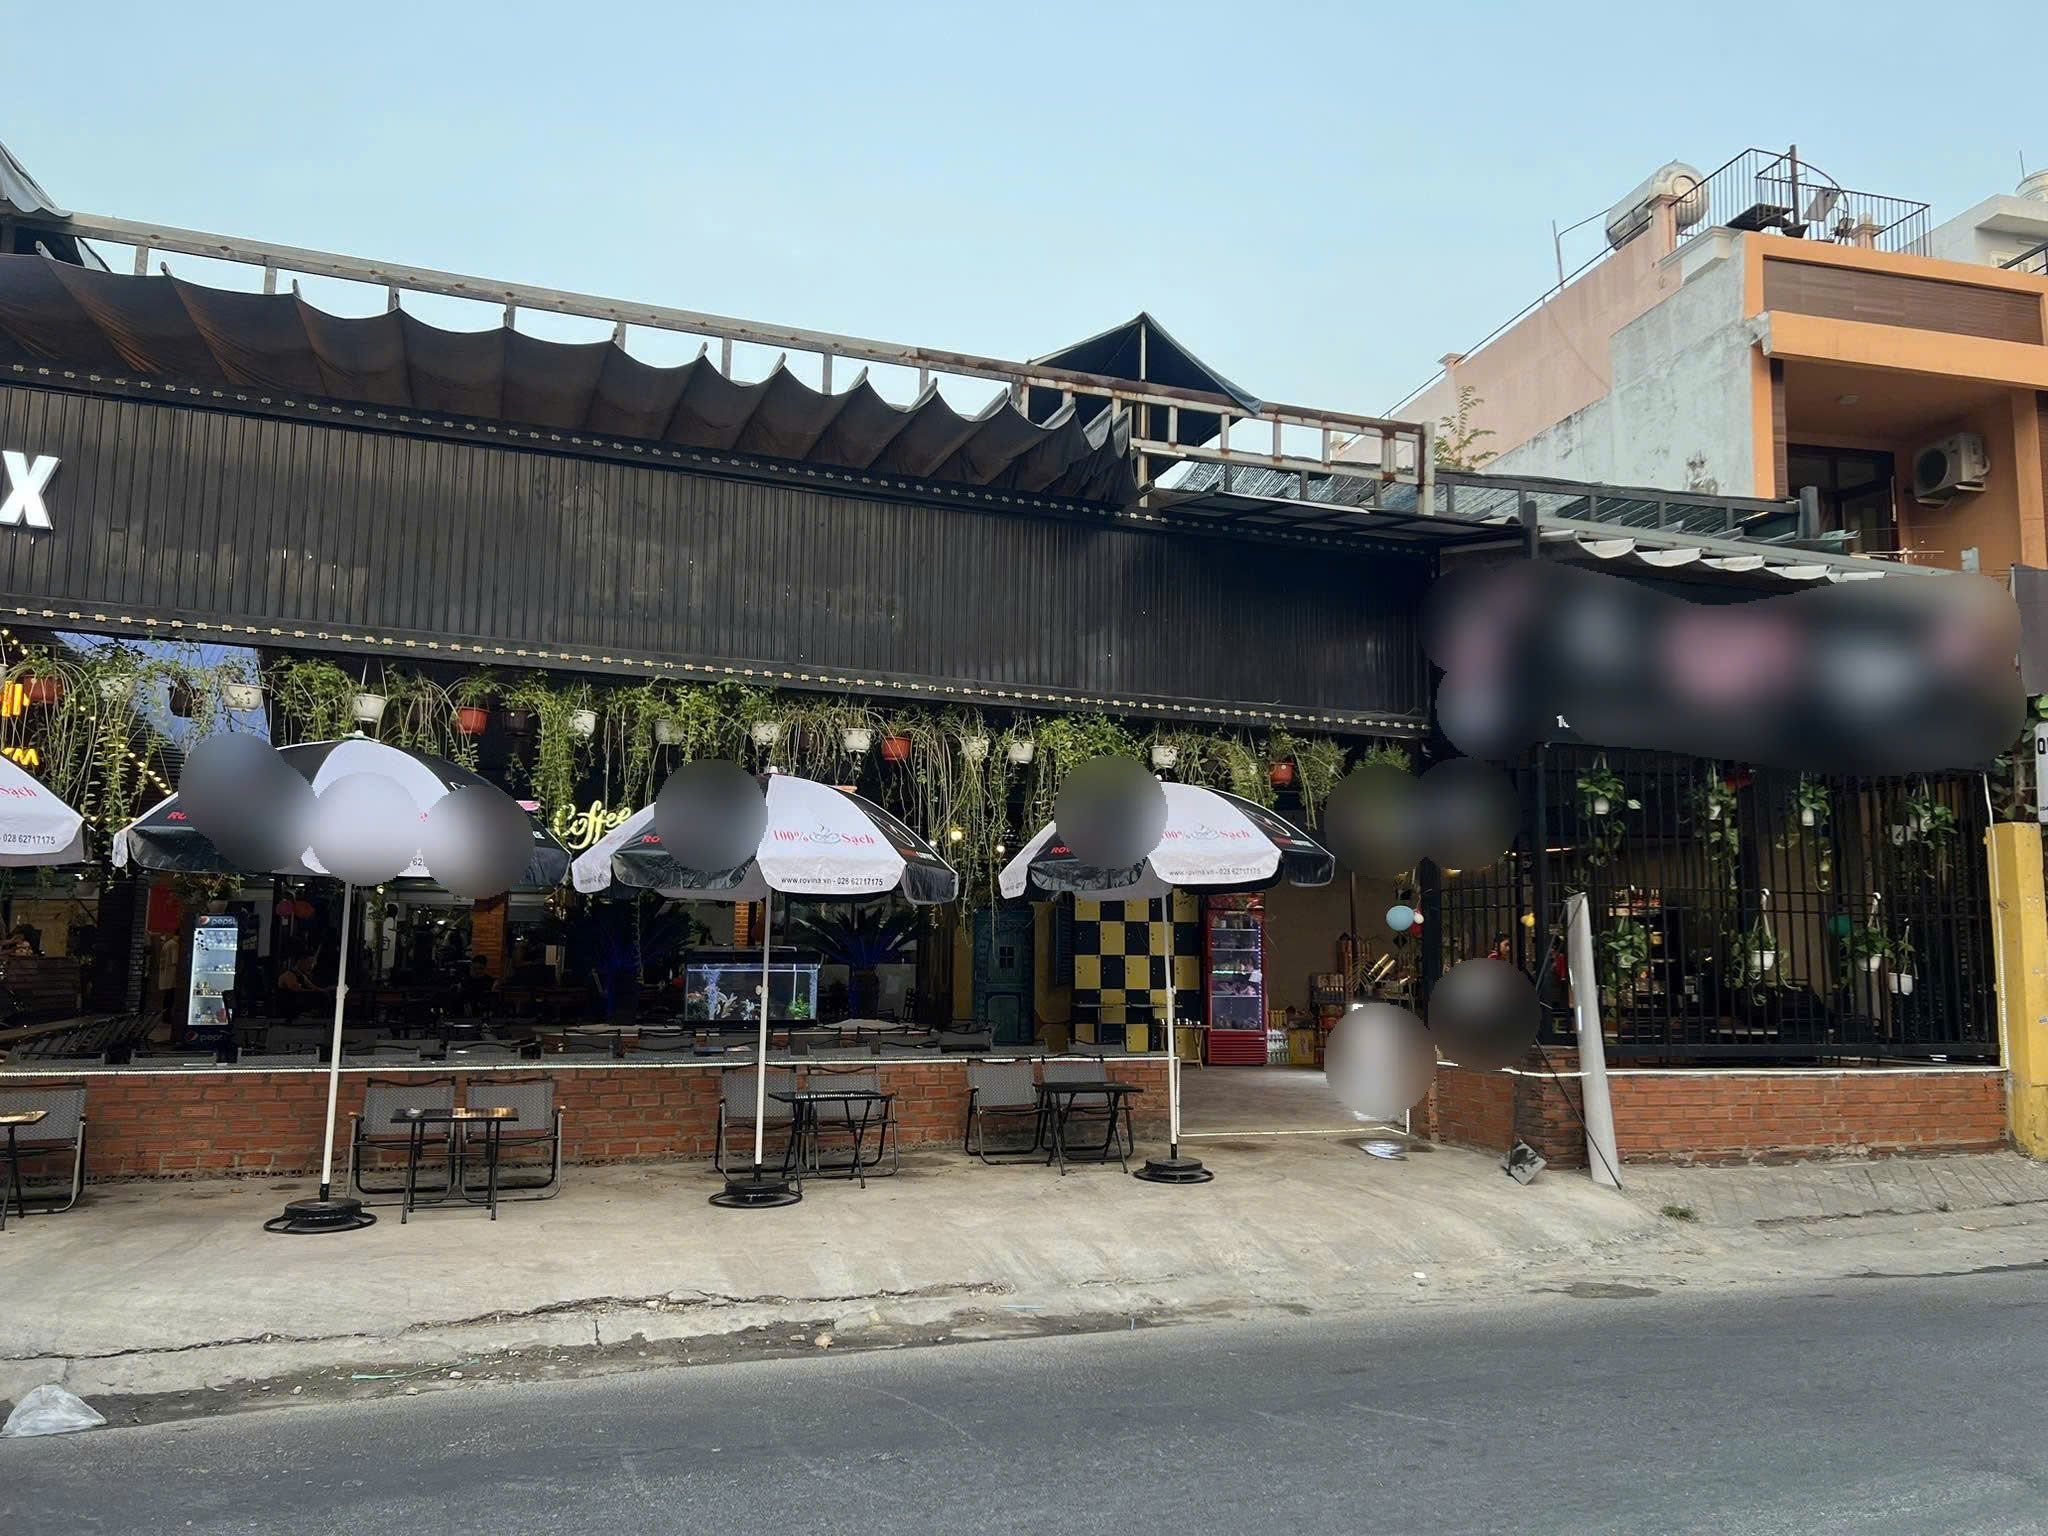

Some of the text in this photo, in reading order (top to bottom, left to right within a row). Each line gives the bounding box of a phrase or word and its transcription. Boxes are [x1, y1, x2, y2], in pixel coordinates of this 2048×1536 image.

[0, 450, 61, 529] X
[3, 833, 56, 845] 028 62717175
[553, 800, 631, 849] Coffee
[774, 829, 875, 846] 100% Sạch
